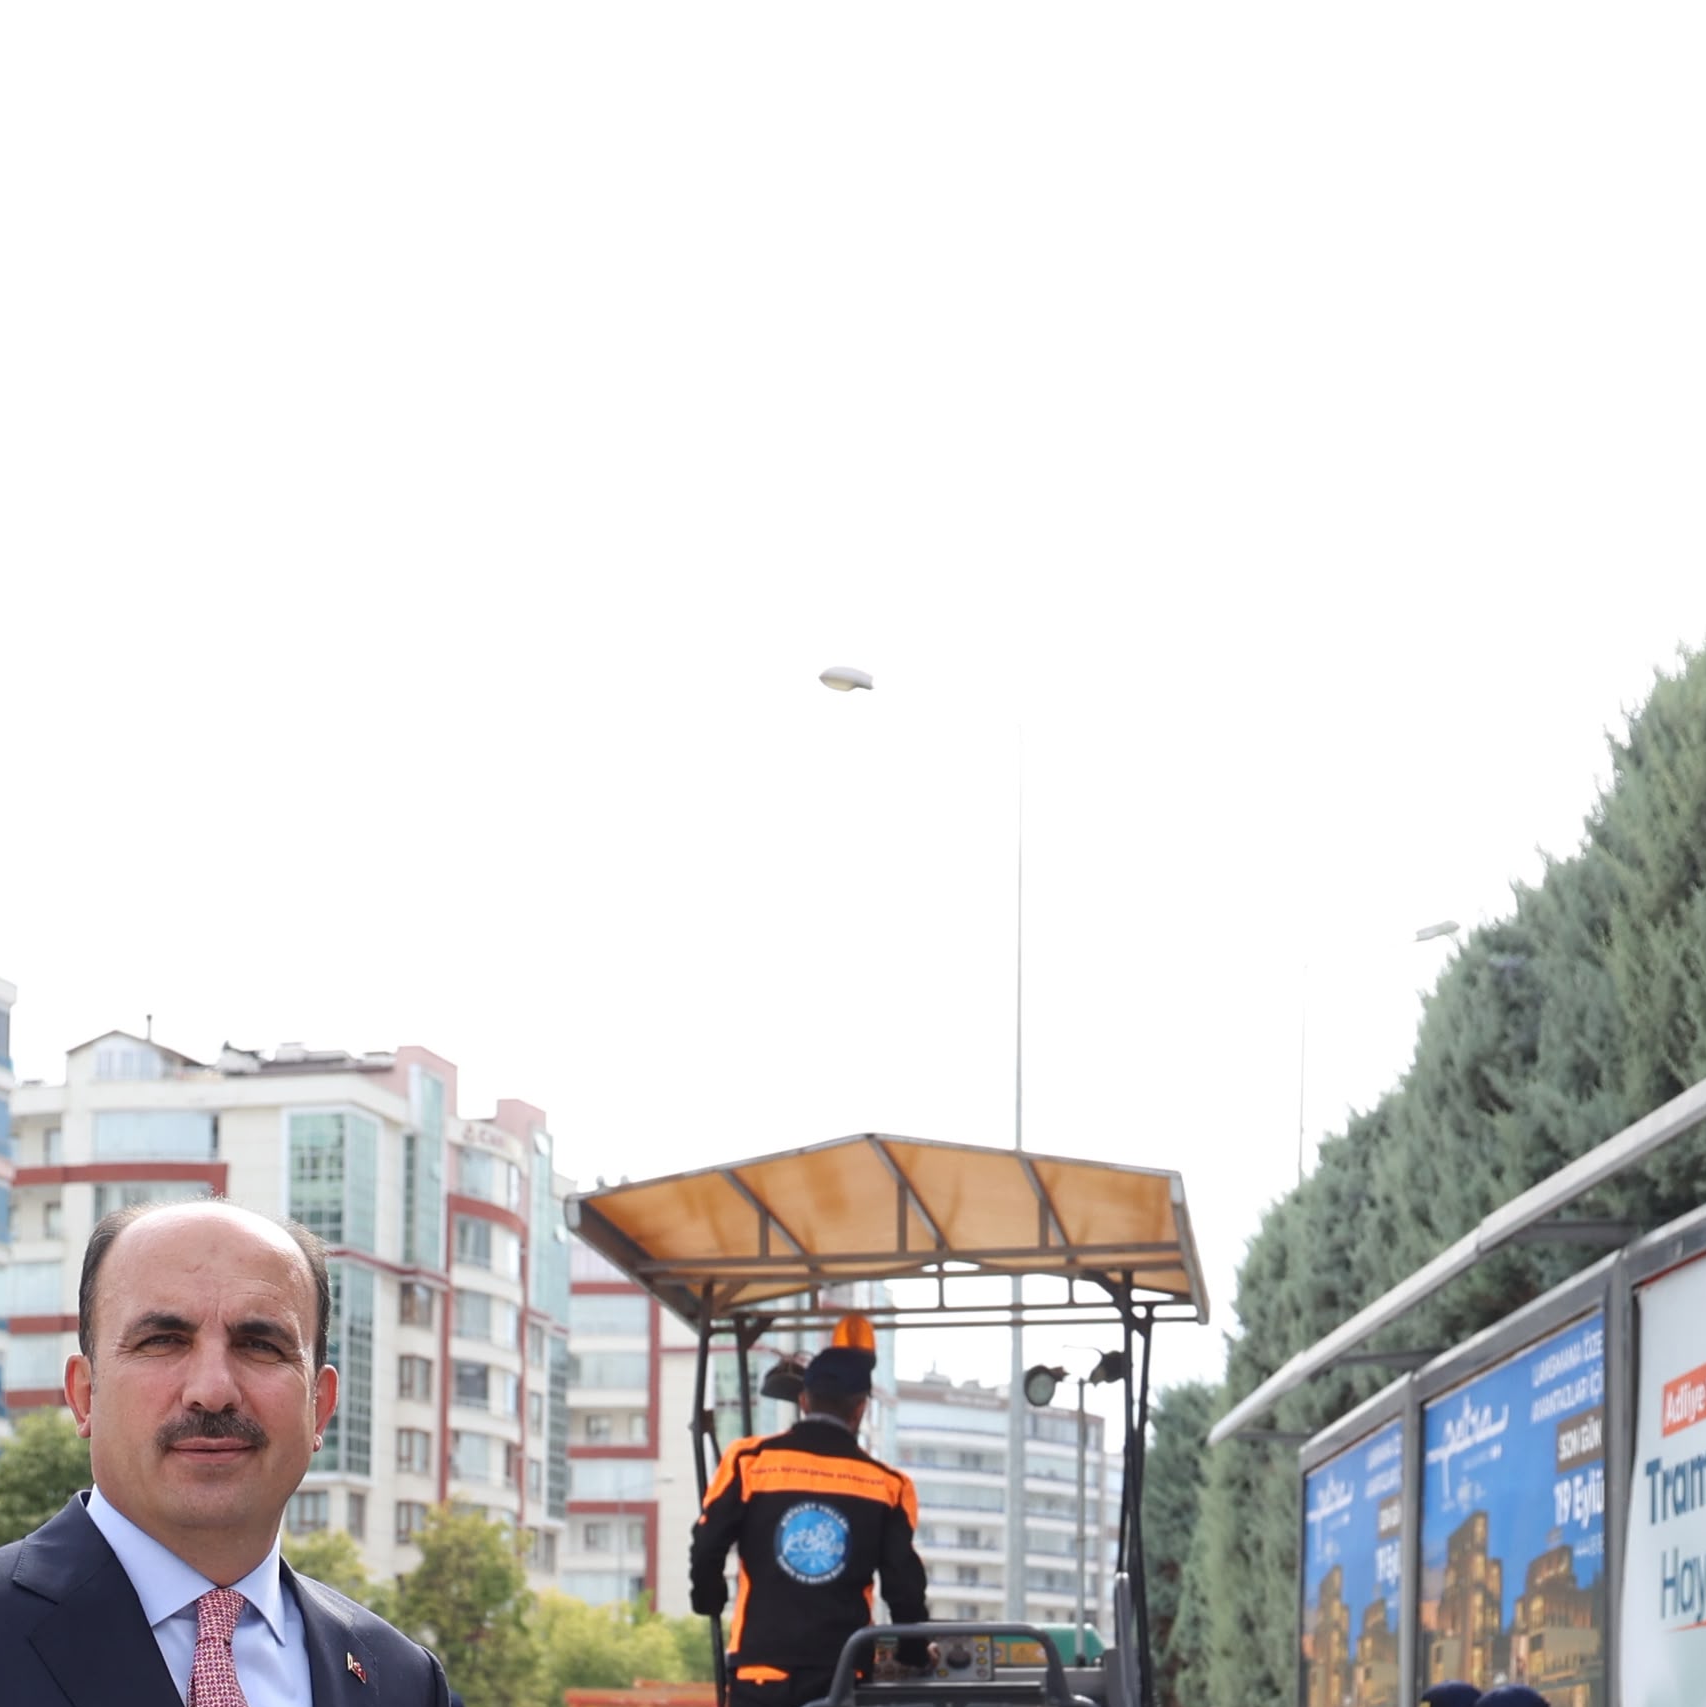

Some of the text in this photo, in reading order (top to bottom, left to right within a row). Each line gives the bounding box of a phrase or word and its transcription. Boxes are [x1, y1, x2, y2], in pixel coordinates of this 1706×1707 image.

[1665, 1382, 1706, 1427] Adliye
[1554, 1468, 1605, 1529] 19 Eylü
